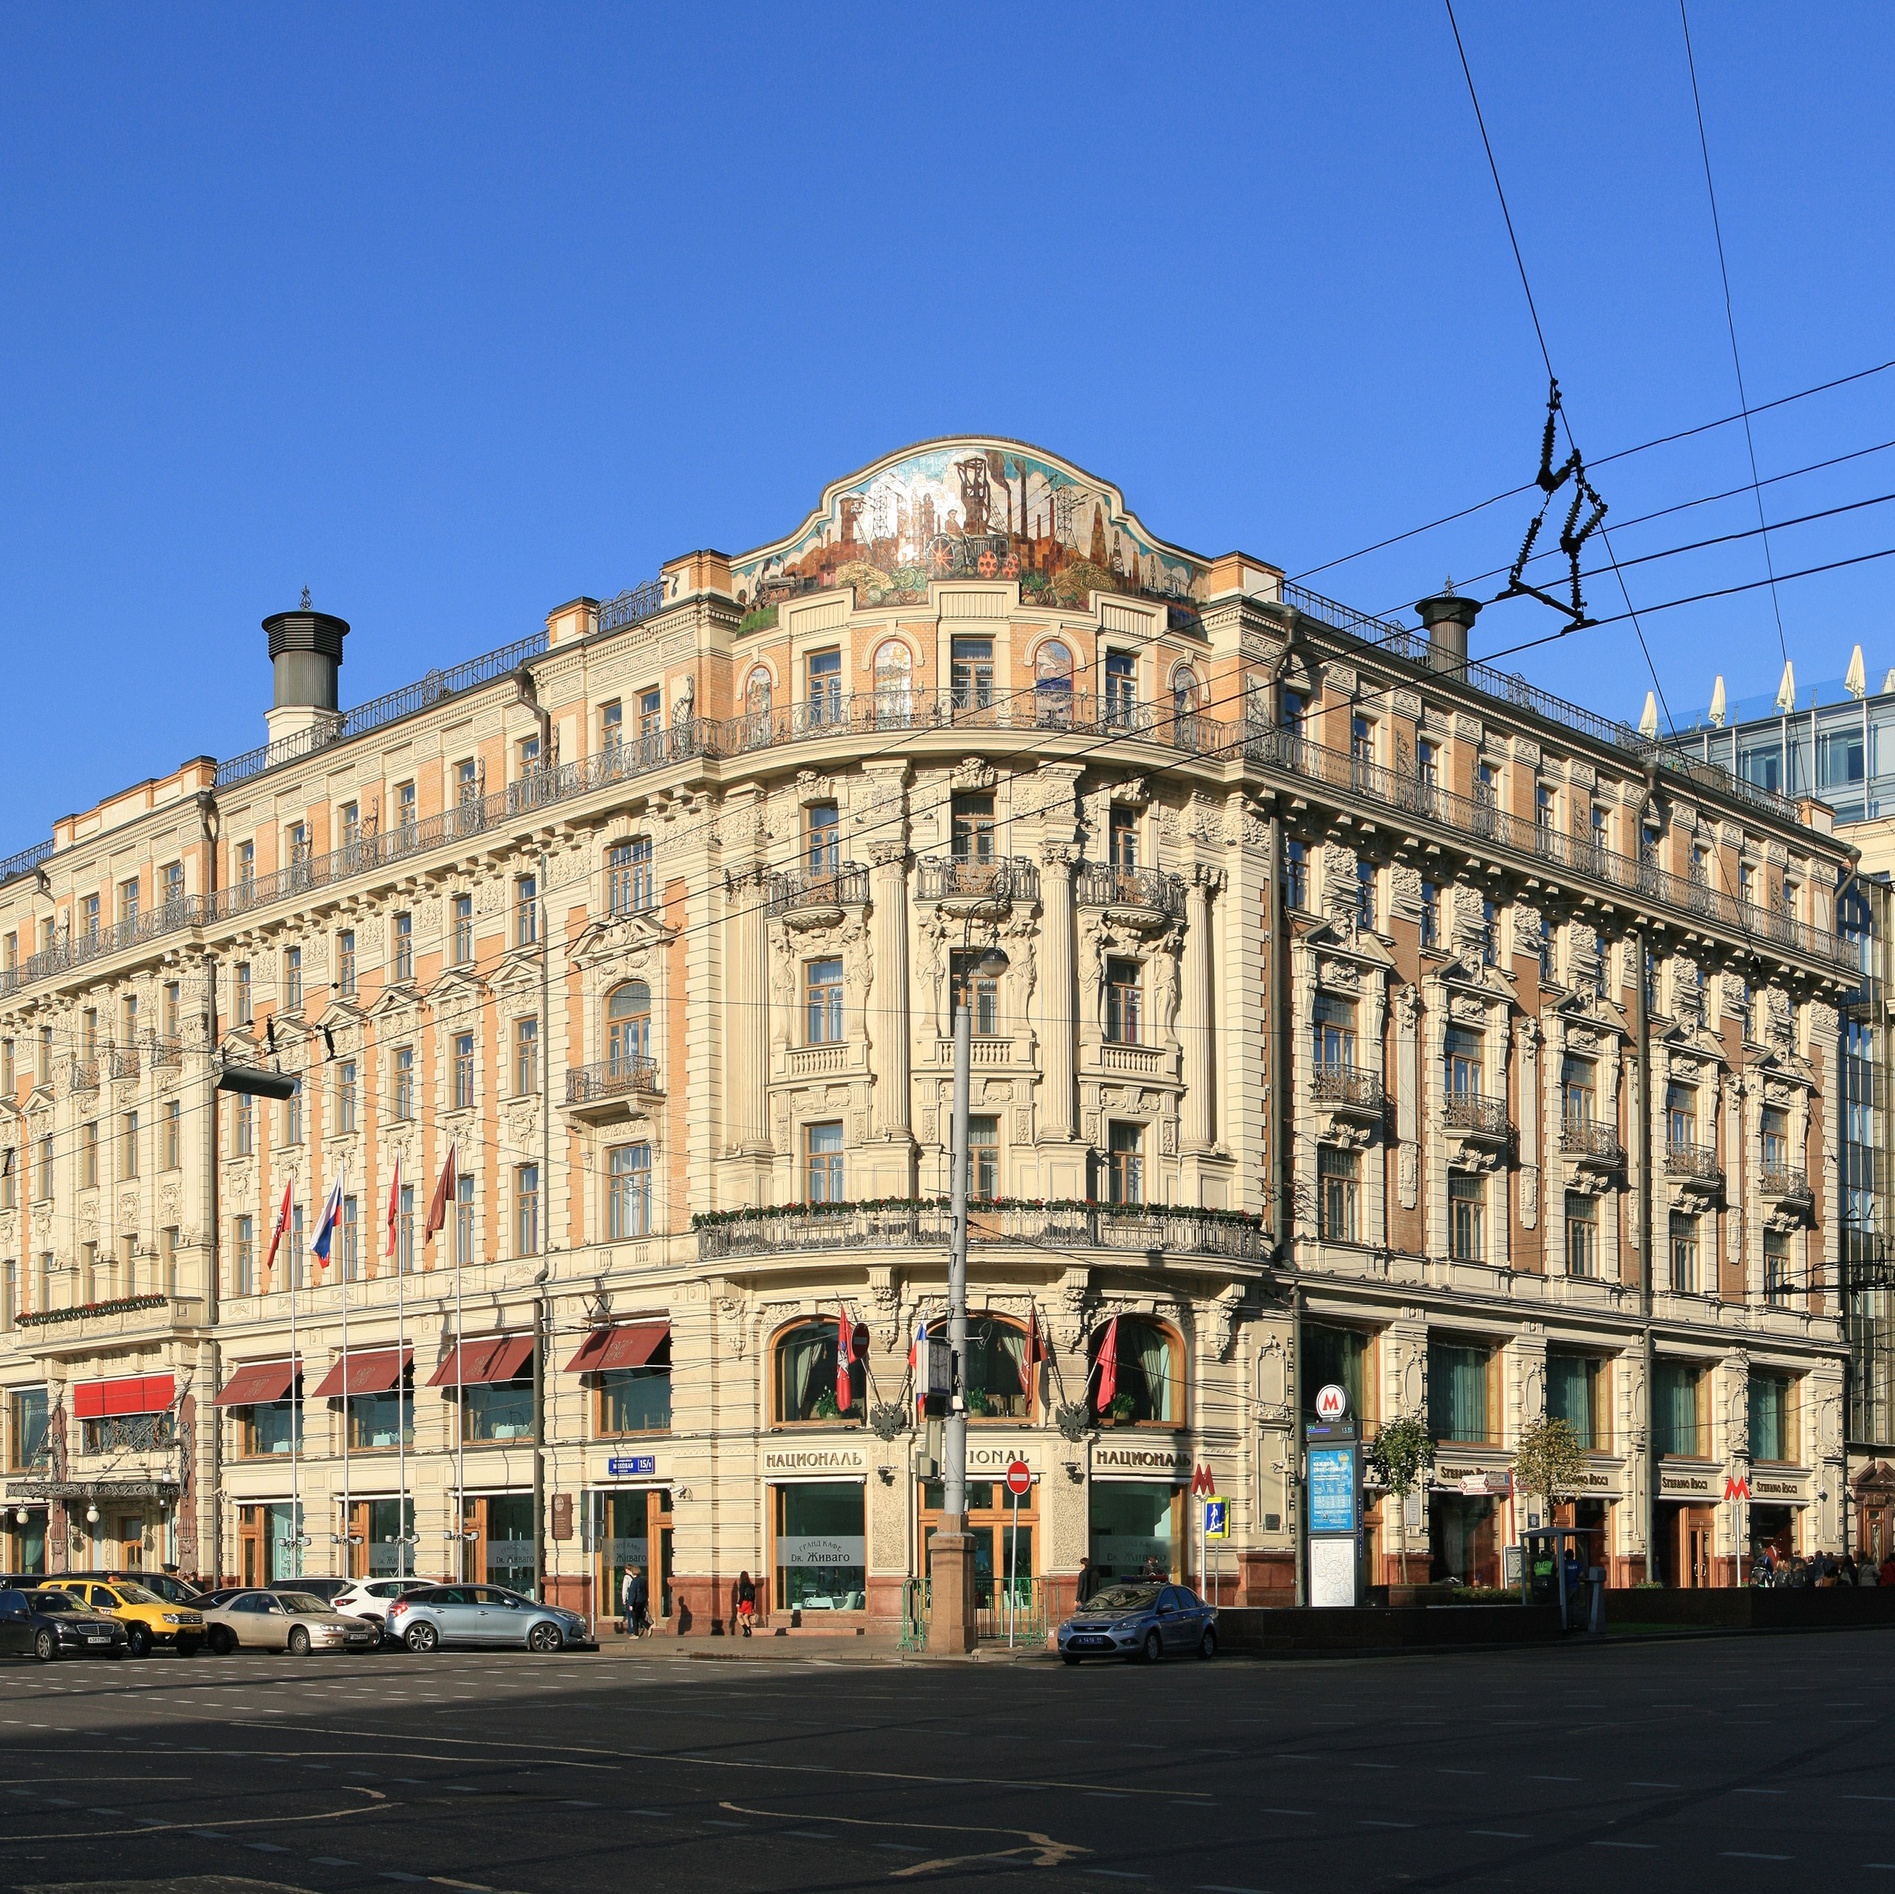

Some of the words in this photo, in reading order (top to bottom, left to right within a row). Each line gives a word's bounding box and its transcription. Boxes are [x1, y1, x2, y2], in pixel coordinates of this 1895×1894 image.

[766, 1452, 863, 1469] НАЦИОНАЛЬ
[1096, 1451, 1192, 1467] НАЦИОНАЛЬ
[822, 1540, 843, 1553] КАФЕ
[807, 1552, 850, 1562] Живаго
